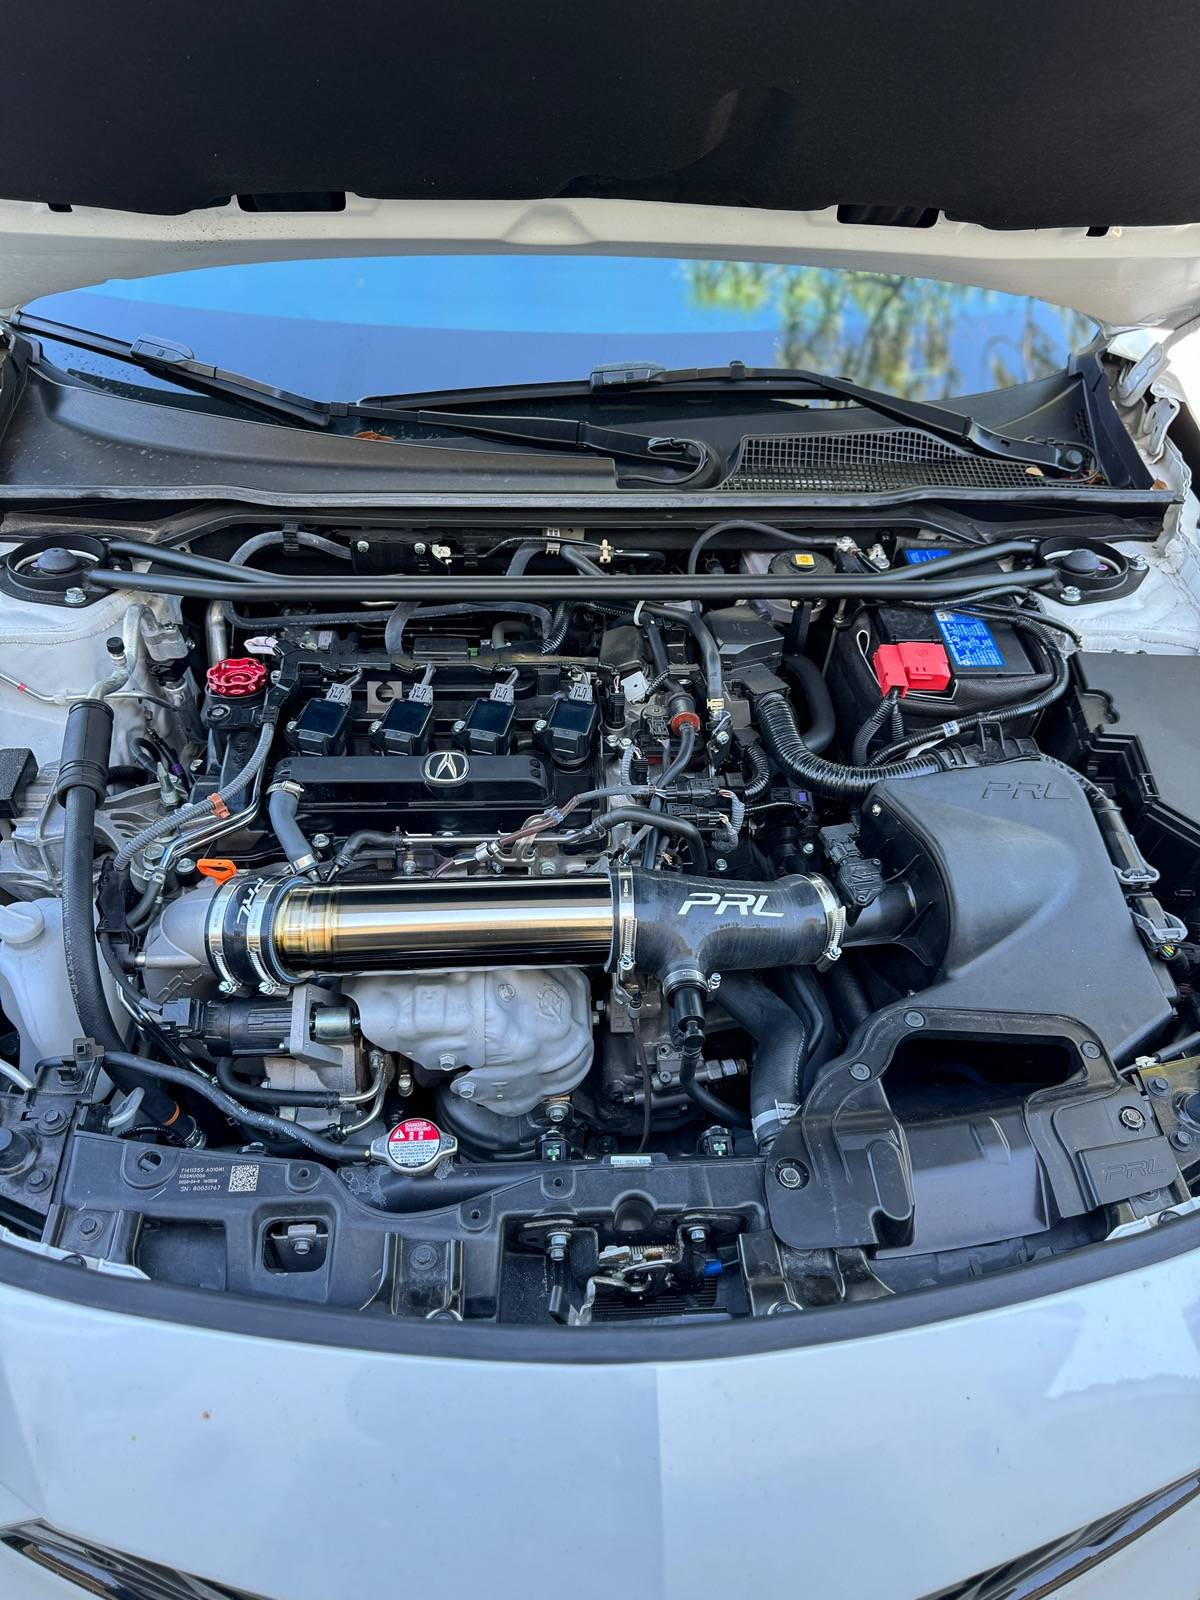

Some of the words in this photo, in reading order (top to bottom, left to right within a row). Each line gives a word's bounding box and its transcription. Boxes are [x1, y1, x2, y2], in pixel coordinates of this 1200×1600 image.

[982, 780, 1072, 800] PRL
[678, 892, 784, 917] PRL
[1106, 1158, 1168, 1181] PRL
